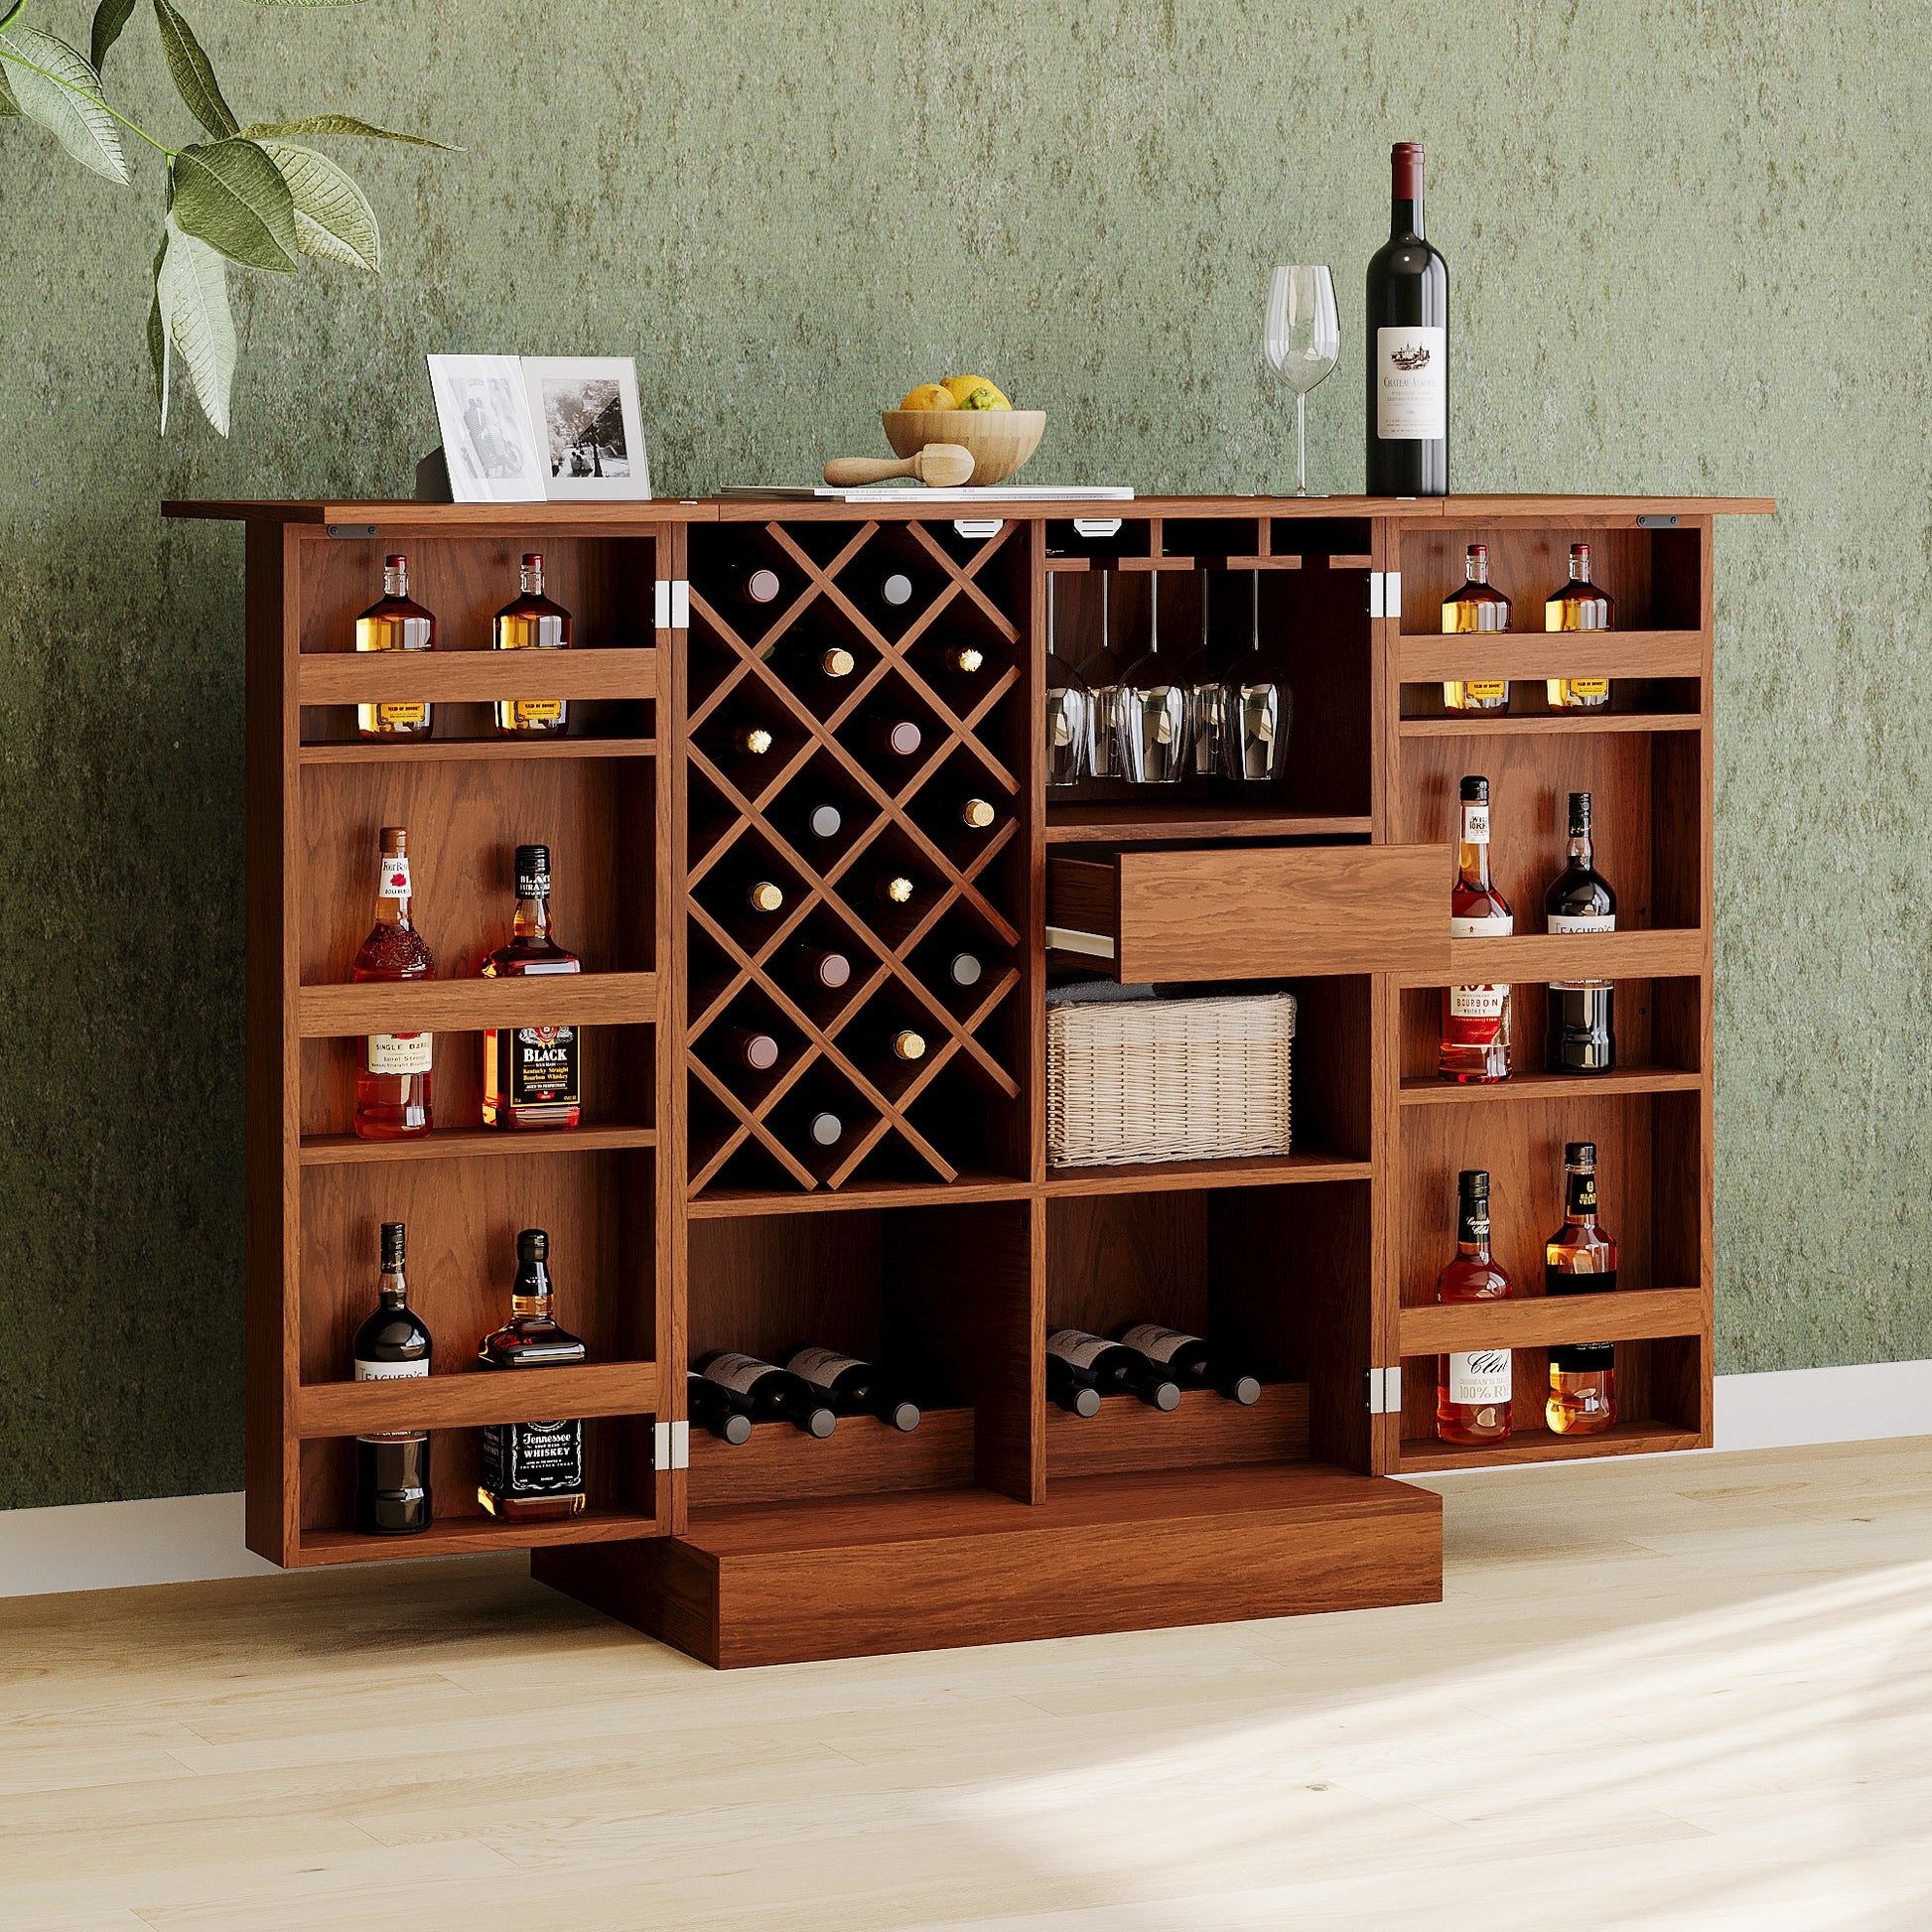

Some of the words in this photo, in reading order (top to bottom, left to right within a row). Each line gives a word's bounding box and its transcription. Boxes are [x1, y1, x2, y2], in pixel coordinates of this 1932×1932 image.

[520, 875, 550, 884] BLAC
[1456, 998, 1498, 1007] BOURBON
[523, 1047, 568, 1062] BLACK
[1460, 1386, 1491, 1399] 100%
[522, 1433, 571, 1445] Tennessee
[523, 1447, 571, 1458] WHISKEY
